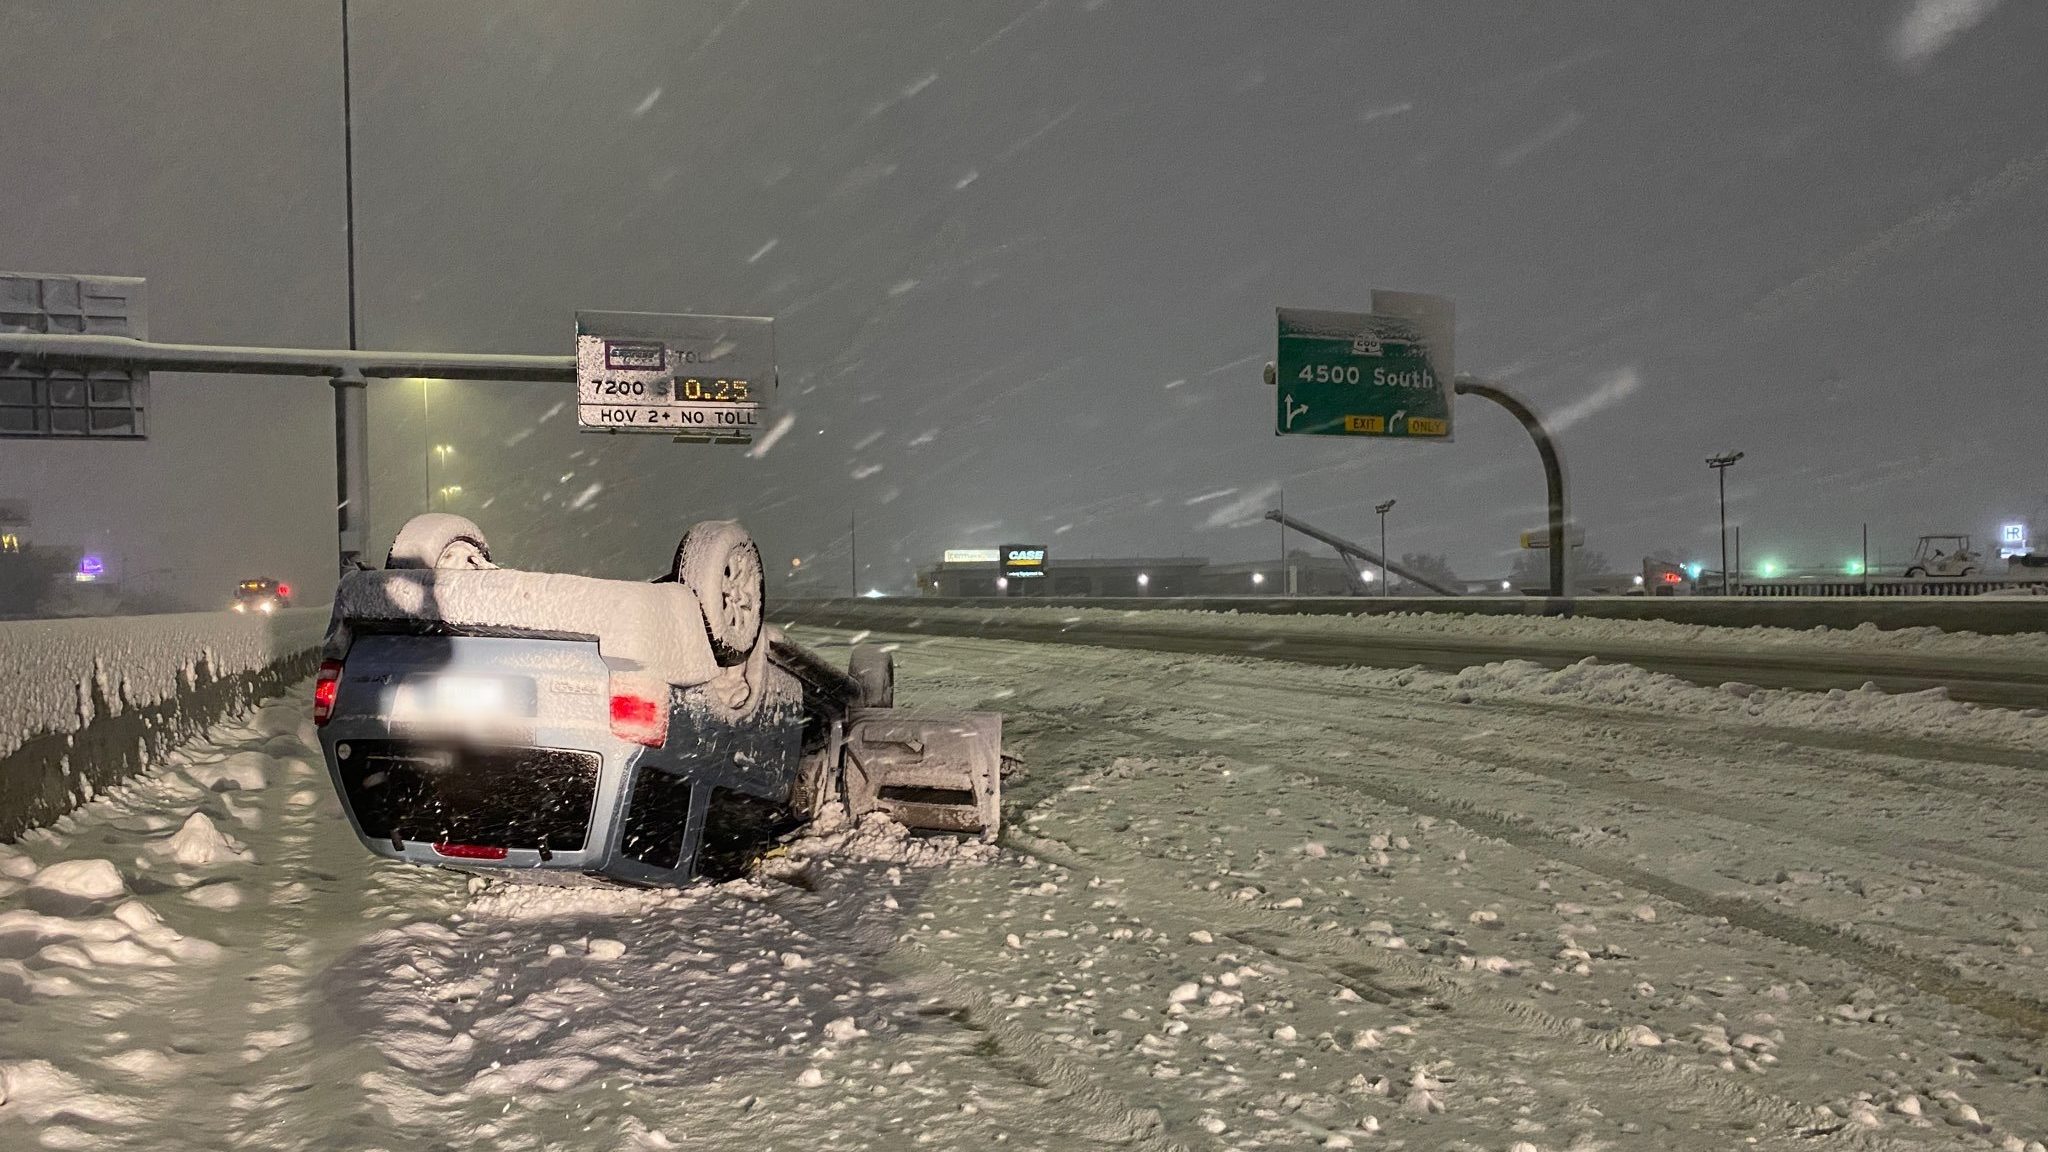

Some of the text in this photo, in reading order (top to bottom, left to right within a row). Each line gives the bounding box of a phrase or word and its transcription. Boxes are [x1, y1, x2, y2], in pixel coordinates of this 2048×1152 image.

[1299, 365, 1433, 389] 4500 South
[591, 380, 644, 395] 7200
[685, 379, 748, 400] 0.25
[601, 410, 757, 425] HOV 2+ NO TOLL
[1353, 418, 1441, 432] EXIT ONLY
[2006, 527, 2020, 539] HR
[1008, 551, 1044, 560] CASE
